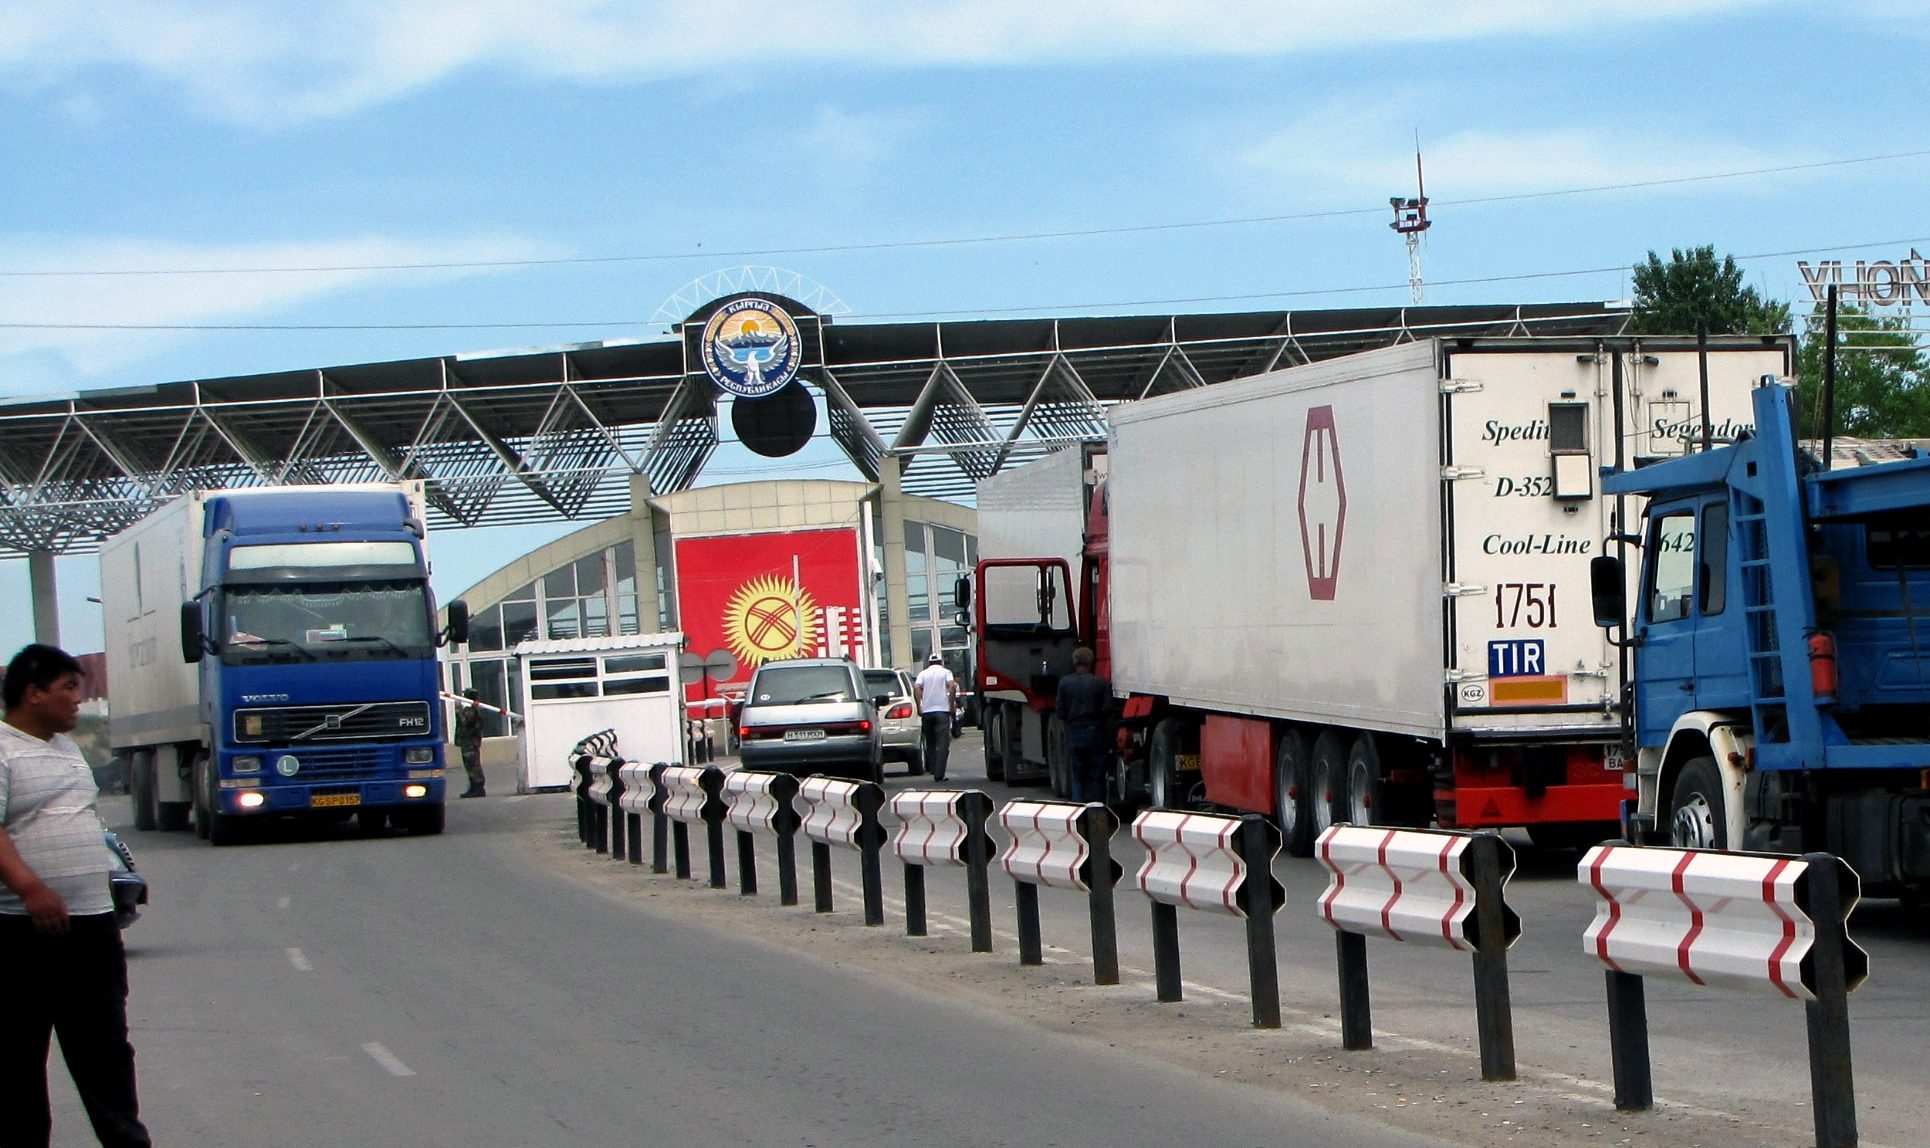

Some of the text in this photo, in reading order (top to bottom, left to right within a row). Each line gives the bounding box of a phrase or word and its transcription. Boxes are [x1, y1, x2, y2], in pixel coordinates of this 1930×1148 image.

[1482, 533, 1591, 555] Cool-Line
[1495, 583, 1557, 629] 1751
[1492, 642, 1540, 675] TIR
[1463, 689, 1482, 698] KGZ
[399, 717, 425, 727] FH12
[283, 759, 293, 772] L
